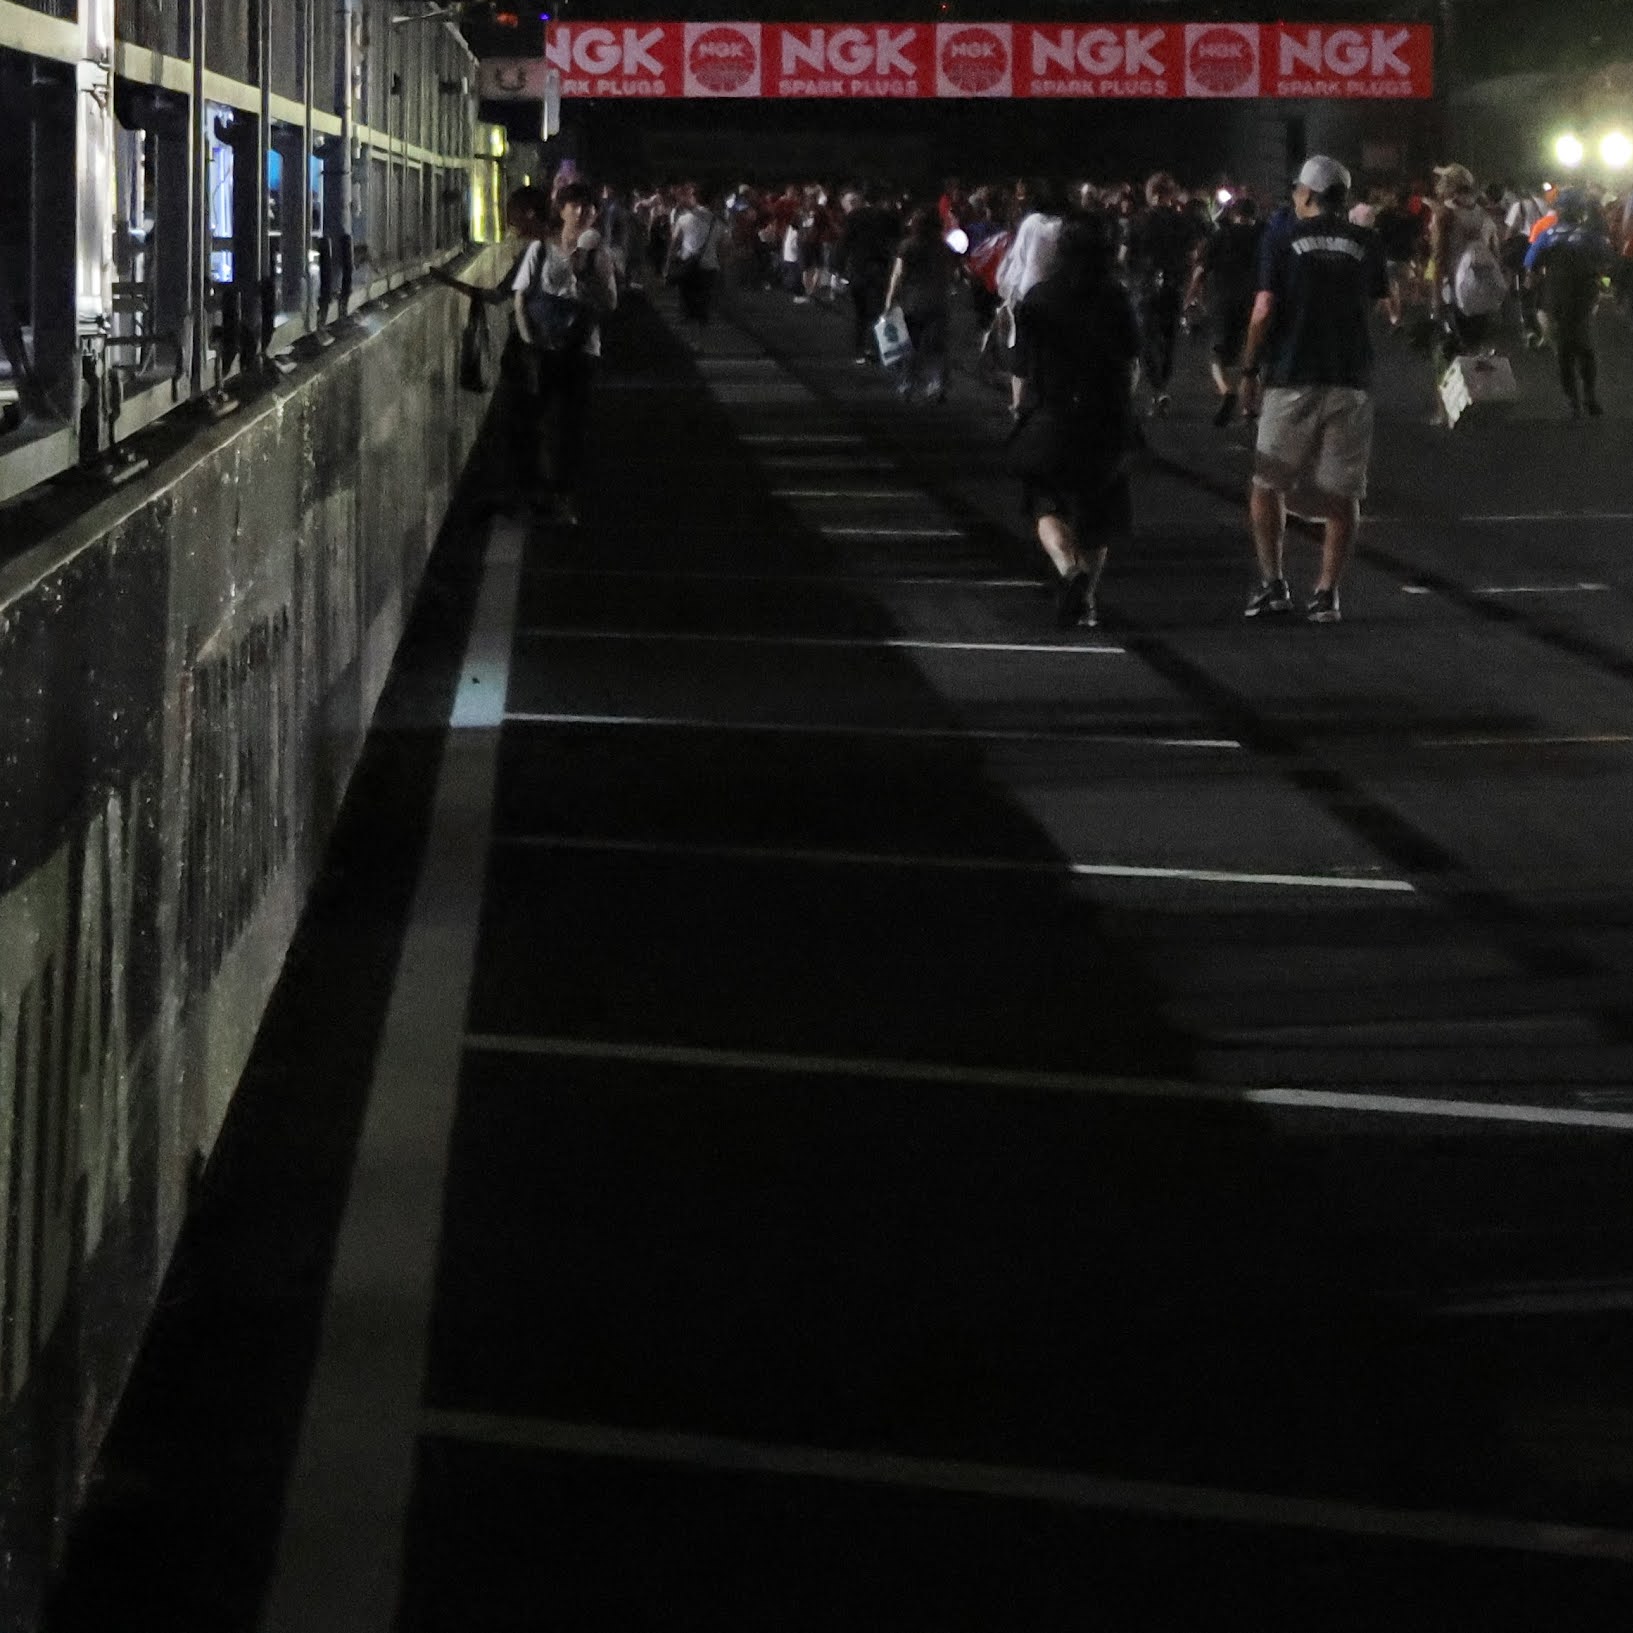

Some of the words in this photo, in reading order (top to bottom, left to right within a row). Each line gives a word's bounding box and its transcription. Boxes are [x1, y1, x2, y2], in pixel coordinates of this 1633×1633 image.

[545, 26, 665, 76] NGK
[781, 28, 917, 76] NGK
[1032, 28, 1166, 76] NGK
[1279, 28, 1411, 76] NGK
[597, 79, 666, 95] PLUGS
[779, 79, 844, 95] SPARK
[851, 79, 918, 95] PLUGS
[1031, 79, 1094, 95] SPARK
[1101, 79, 1168, 95] PLUGS
[1277, 79, 1341, 95] SPARK
[1346, 79, 1413, 95] PLUGS
